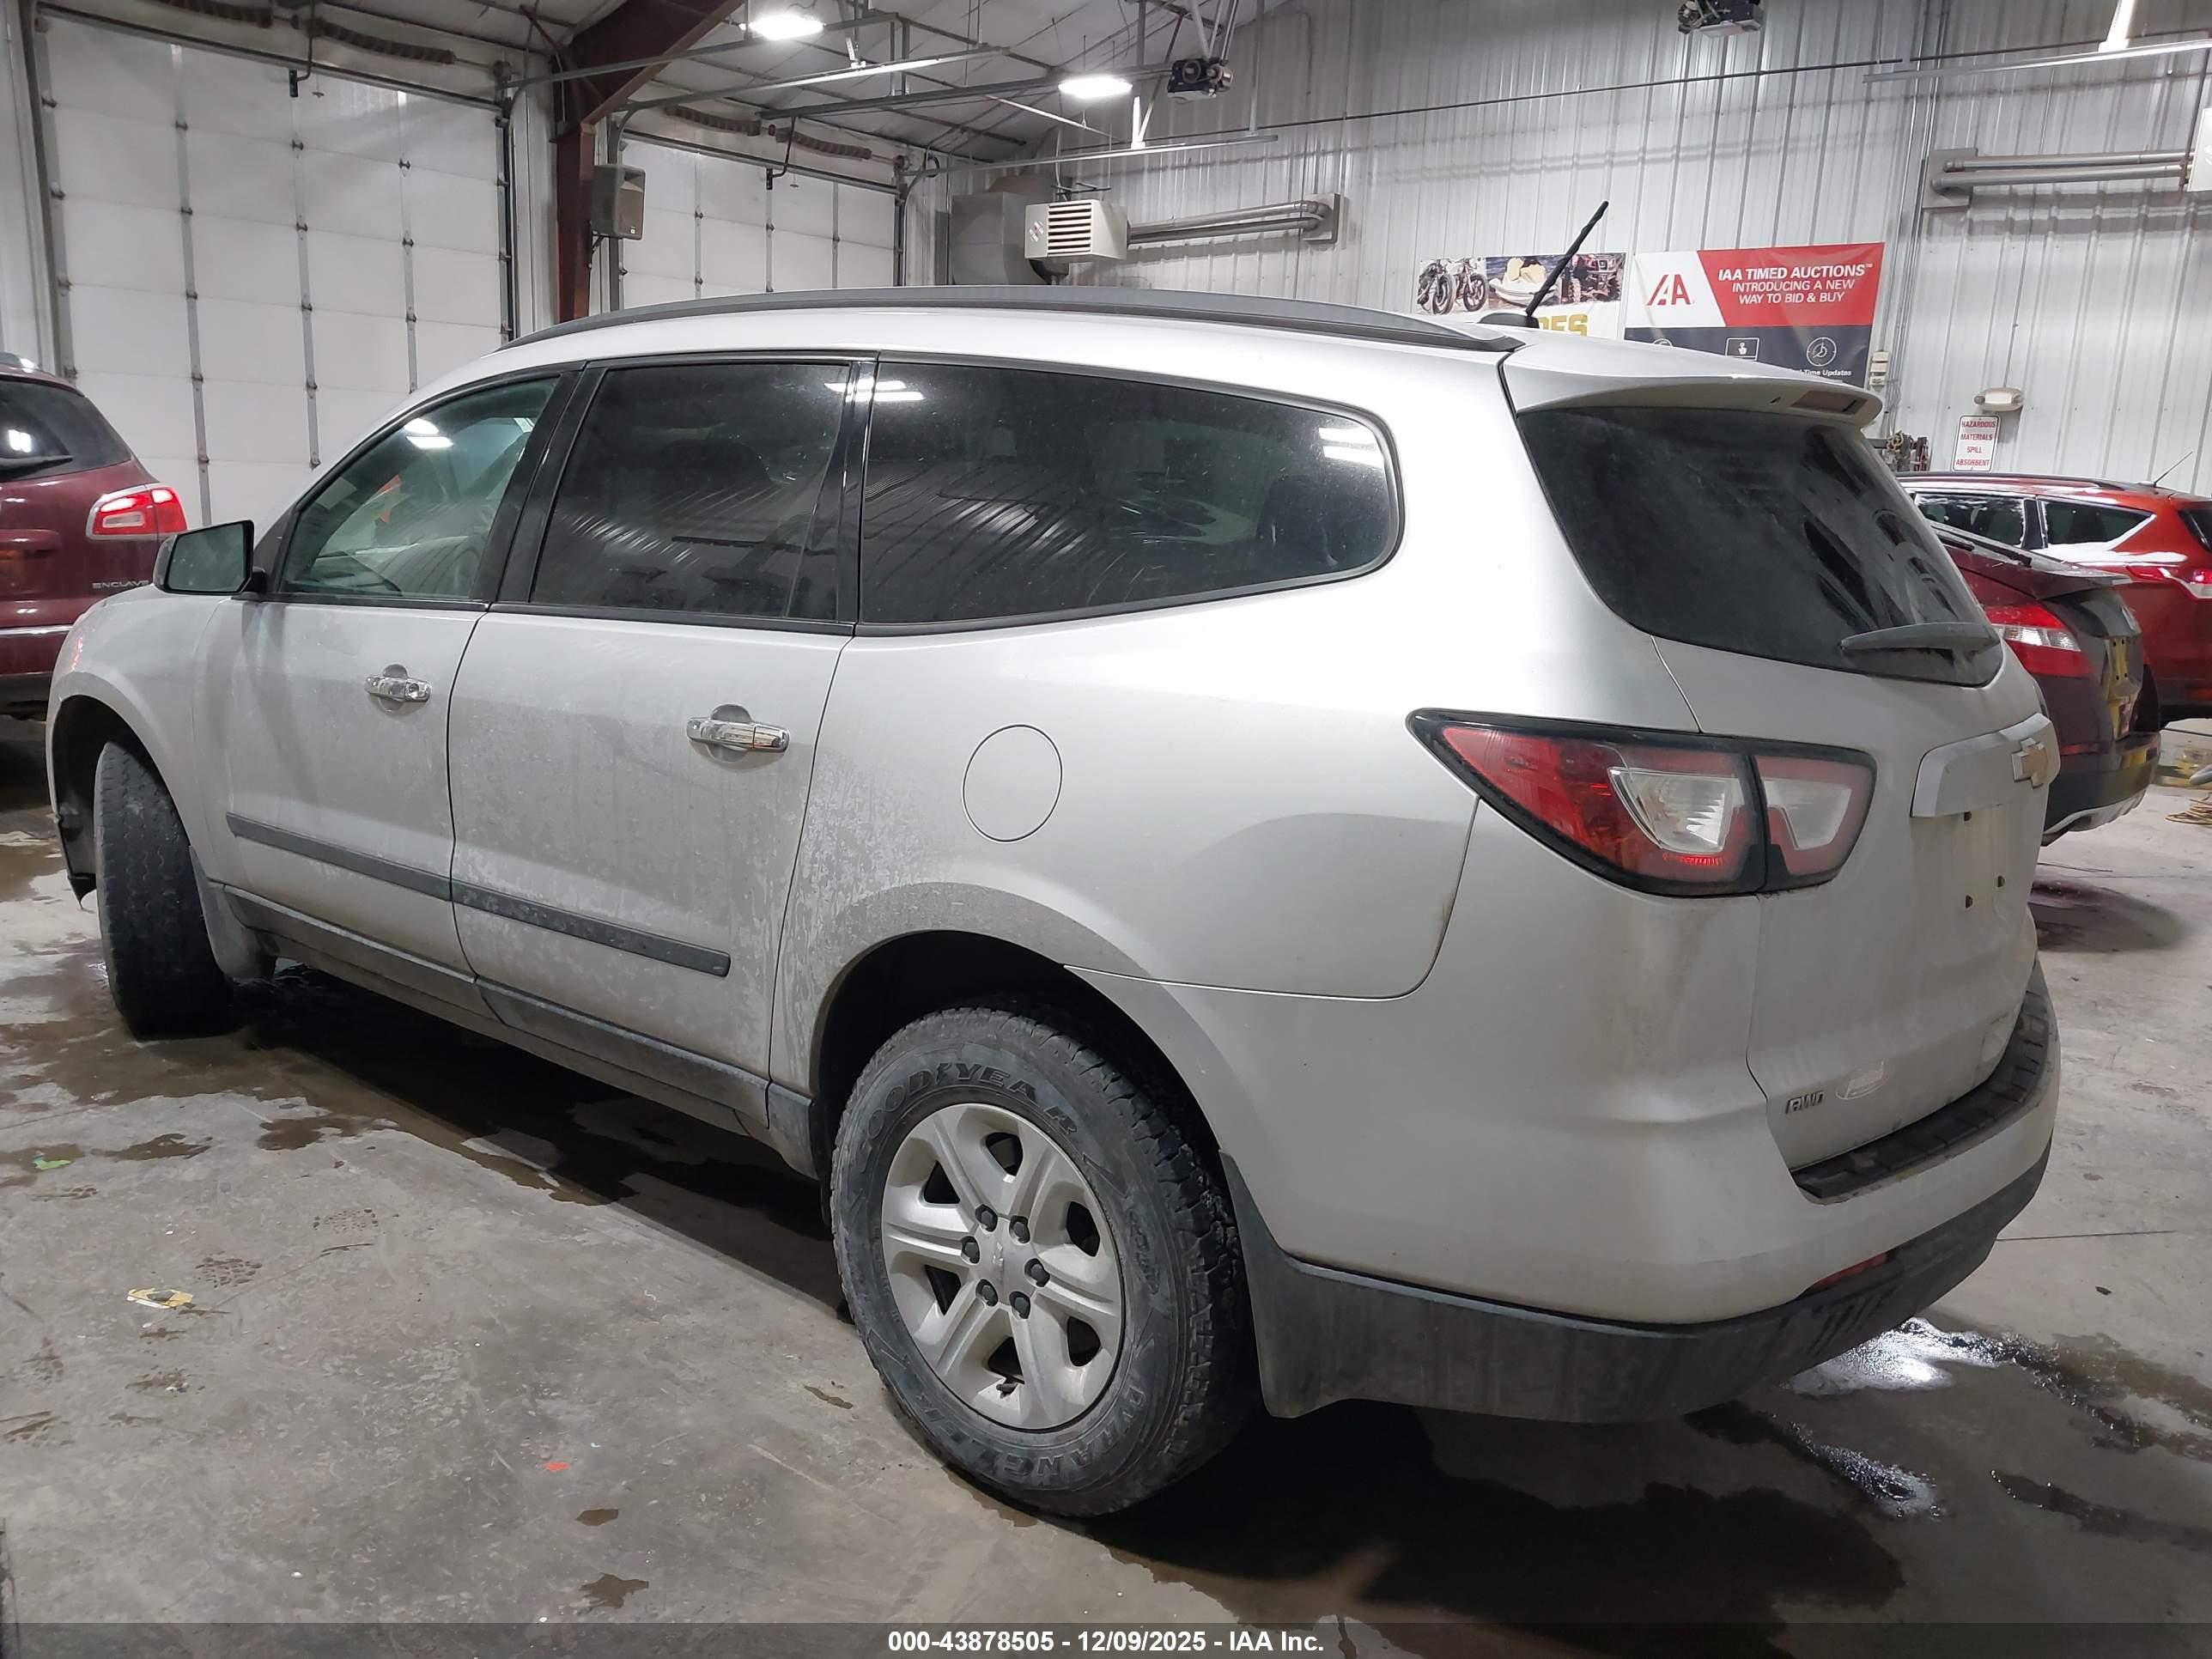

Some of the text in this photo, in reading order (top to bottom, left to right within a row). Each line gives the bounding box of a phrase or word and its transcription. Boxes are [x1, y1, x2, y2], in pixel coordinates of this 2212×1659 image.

[1718, 269, 1742, 281] IAA
[1746, 267, 1787, 280] TIMED
[1732, 279, 1855, 293] INTRODUCING A NEW
[1739, 292, 1845, 305] WAY TO BID & BUY
[92, 580, 149, 589] ENCLAVE
[856, 1062, 1078, 1174] GOODYEAR
